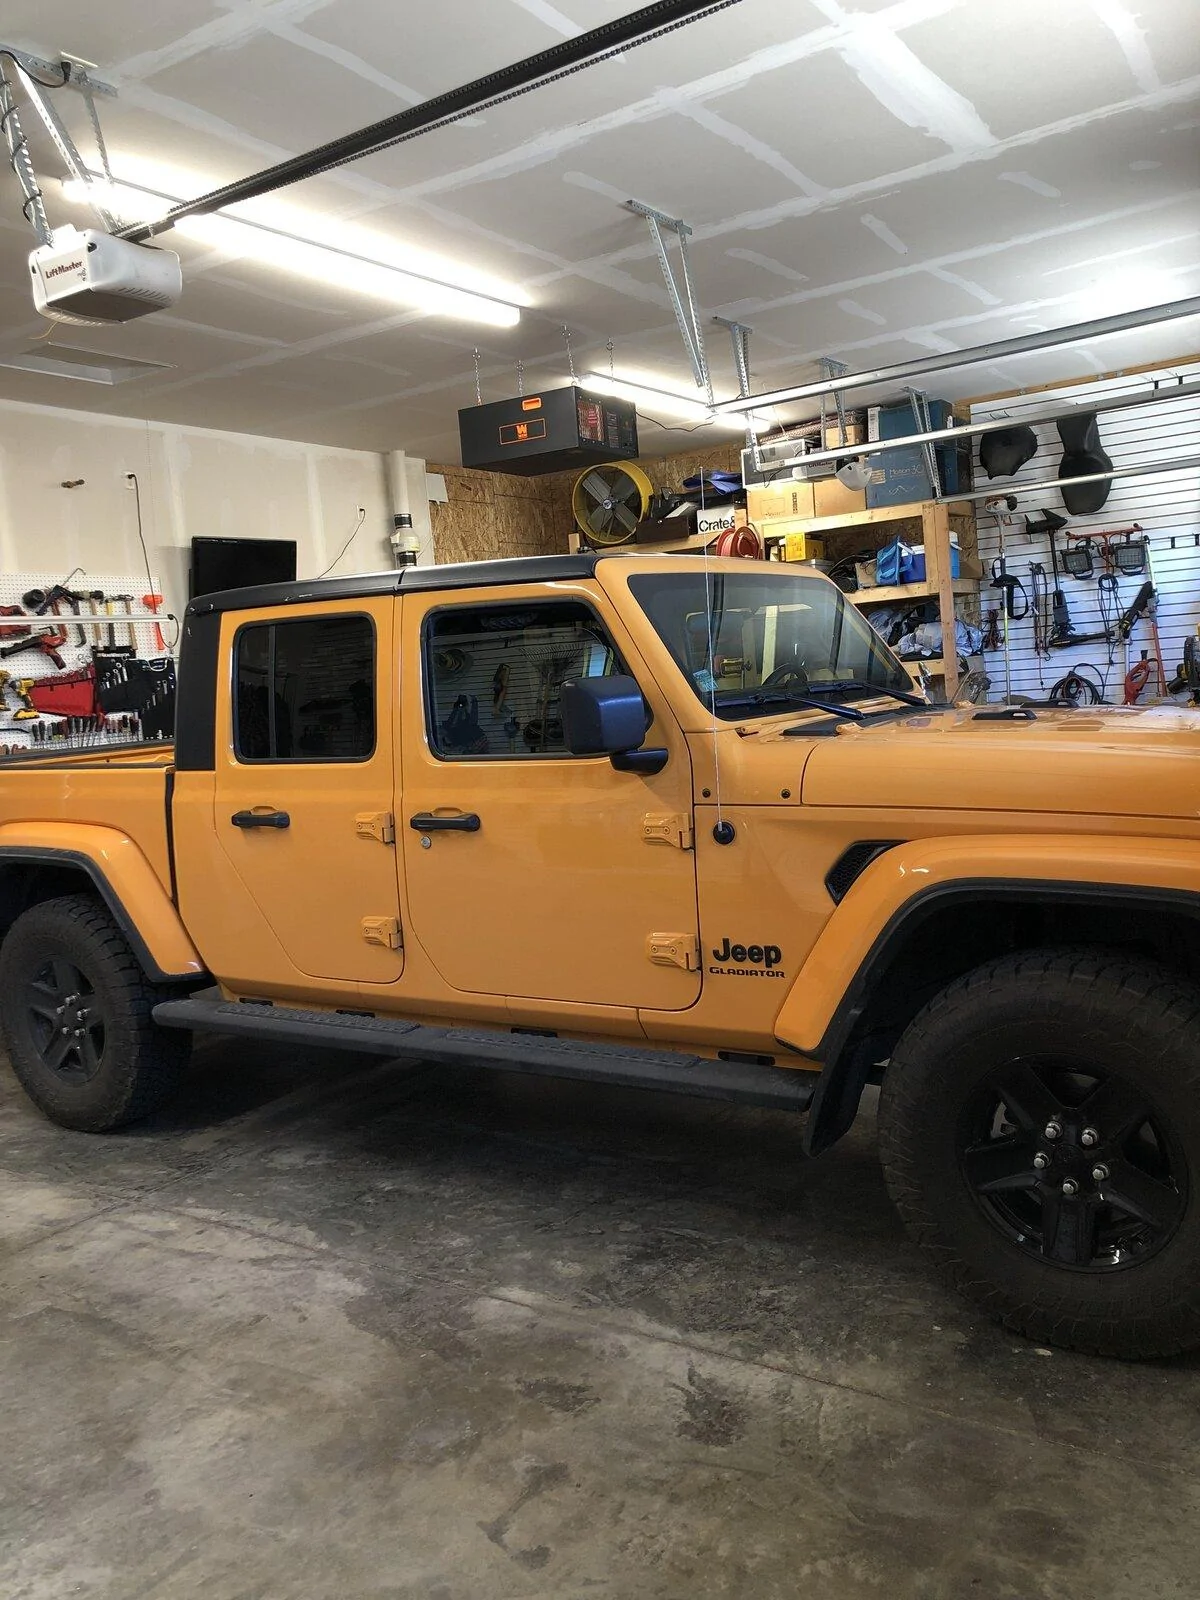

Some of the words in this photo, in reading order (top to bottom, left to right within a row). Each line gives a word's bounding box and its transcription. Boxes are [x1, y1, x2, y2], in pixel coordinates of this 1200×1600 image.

[45, 261, 82, 279] LiftMaster
[713, 938, 782, 968] Jeep
[709, 966, 785, 978] GLADIATOR
